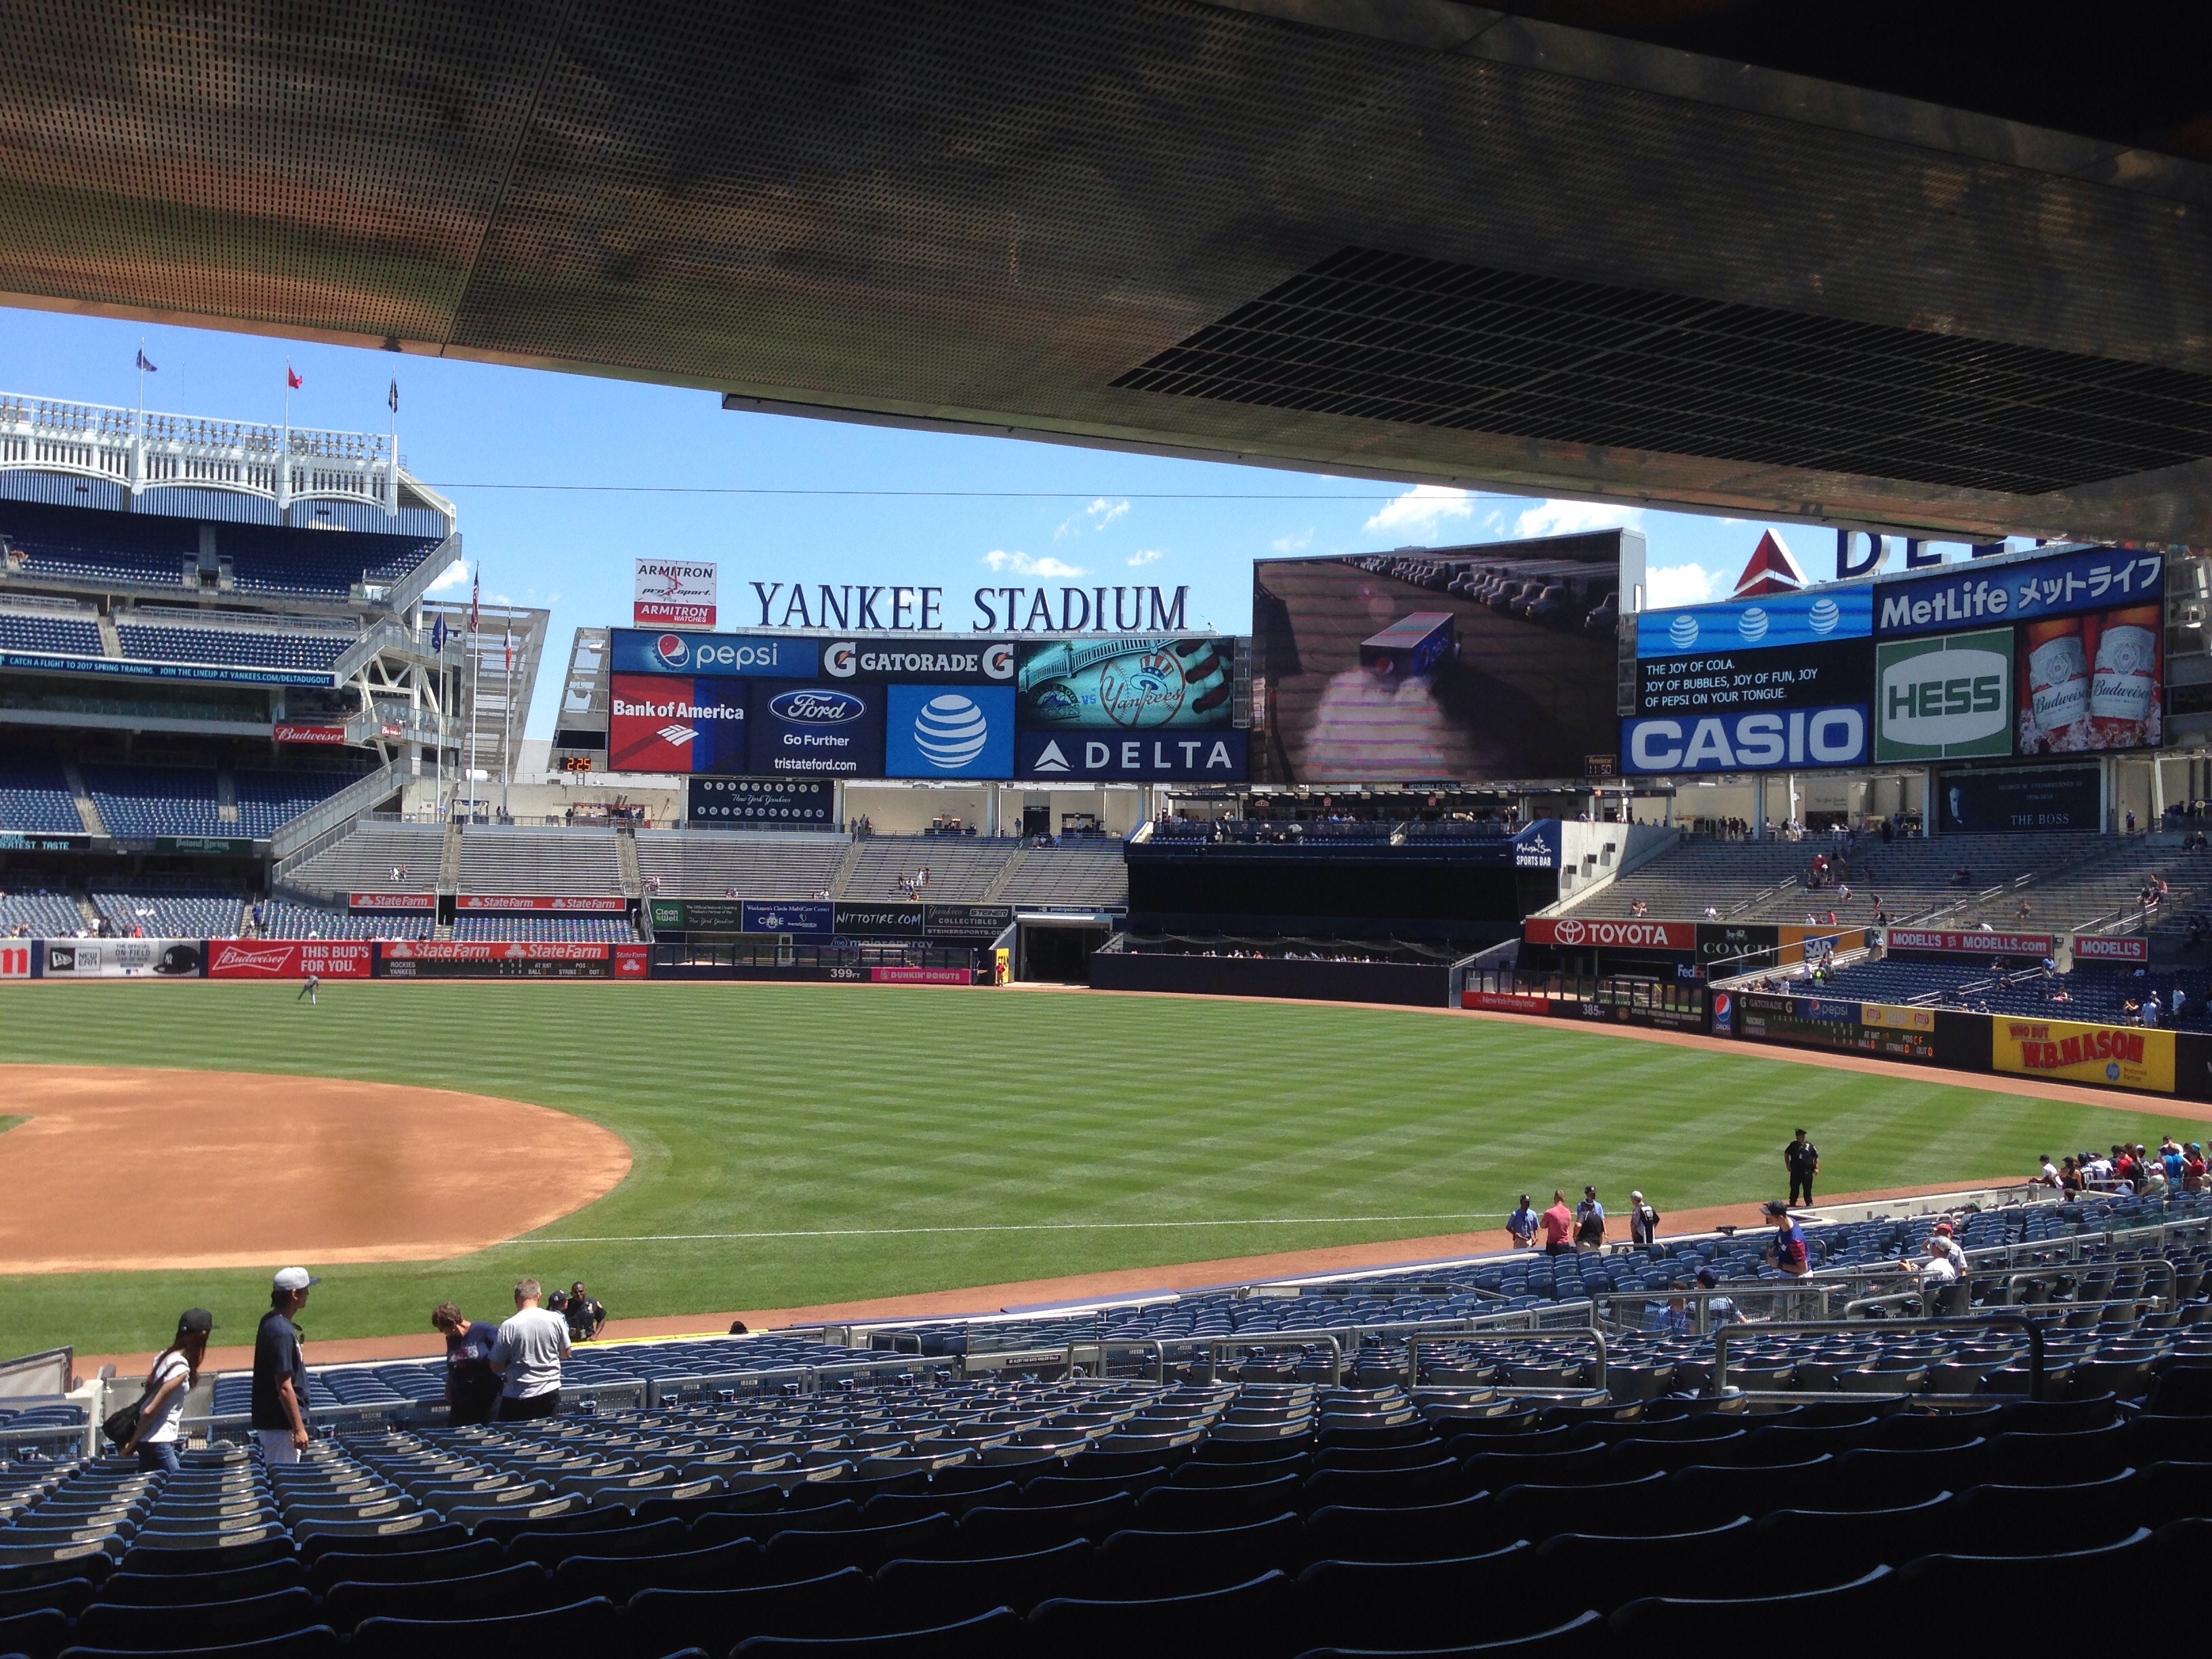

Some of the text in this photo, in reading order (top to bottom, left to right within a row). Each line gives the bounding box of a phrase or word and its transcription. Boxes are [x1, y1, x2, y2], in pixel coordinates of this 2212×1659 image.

[638, 565, 713, 578] ARMITRON
[1881, 556, 2162, 629] MetLife メットライフ
[641, 605, 708, 617] ARMITRON
[749, 581, 1190, 632] YANKEE STADIUM
[697, 642, 778, 670] pepsi
[824, 642, 1015, 679] G GATORADE G
[9, 657, 33, 666] CATCH
[41, 659, 64, 668] FLIGHT
[77, 662, 92, 670] 2017
[94, 663, 119, 672] SPRING
[121, 665, 155, 674] TRAINING.
[178, 668, 192, 676] THE
[193, 669, 218, 678] LINEUP
[1646, 659, 1735, 676] THE JOY OF COLA.
[1645, 668, 1818, 693] JOY OF BUBBLES, JOY OF FUN, JOY
[1645, 688, 1787, 708] OF PEPSI ON YOUR TONGUE.
[1889, 674, 2001, 720] HESS
[613, 700, 744, 720] Bank of America
[797, 689, 846, 720] Ford
[276, 727, 344, 741] Budweiser
[783, 735, 850, 746] Go Further
[1631, 709, 1864, 769] CASIO
[1086, 741, 1232, 769] DELTA
[567, 757, 590, 771] 2:25
[775, 758, 857, 771] tristateford.com
[732, 794, 792, 806] New York Yankees
[2011, 813, 2070, 825] THE BOSS
[42, 841, 69, 850] TASTE
[176, 838, 230, 851] Poland Spring
[1516, 855, 1551, 866] SPORTS BAR
[836, 912, 921, 926] NITTOTIRE.COM
[928, 905, 1008, 919] Yankees STEINER
[1589, 924, 1669, 945] TOYOTA
[1703, 943, 1771, 957] COACH
[1805, 941, 1831, 956] SAP
[1893, 933, 2046, 953] MODELL'S MODELLS.com
[2081, 941, 2141, 956] MODELL'S
[220, 951, 286, 964] Budweiser
[301, 945, 369, 958] THIS BUD'S
[301, 960, 356, 972] FOR YOU.
[1677, 964, 1706, 979] FedEx
[890, 971, 960, 980] DUNKIN' DONUTS
[1749, 1000, 1782, 1010] GATORADE
[1822, 1004, 1848, 1017] pepsi
[2009, 1025, 2049, 1038] WHO BUT
[1903, 1035, 1913, 1043] POS
[1917, 1047, 1927, 1055] OUT
